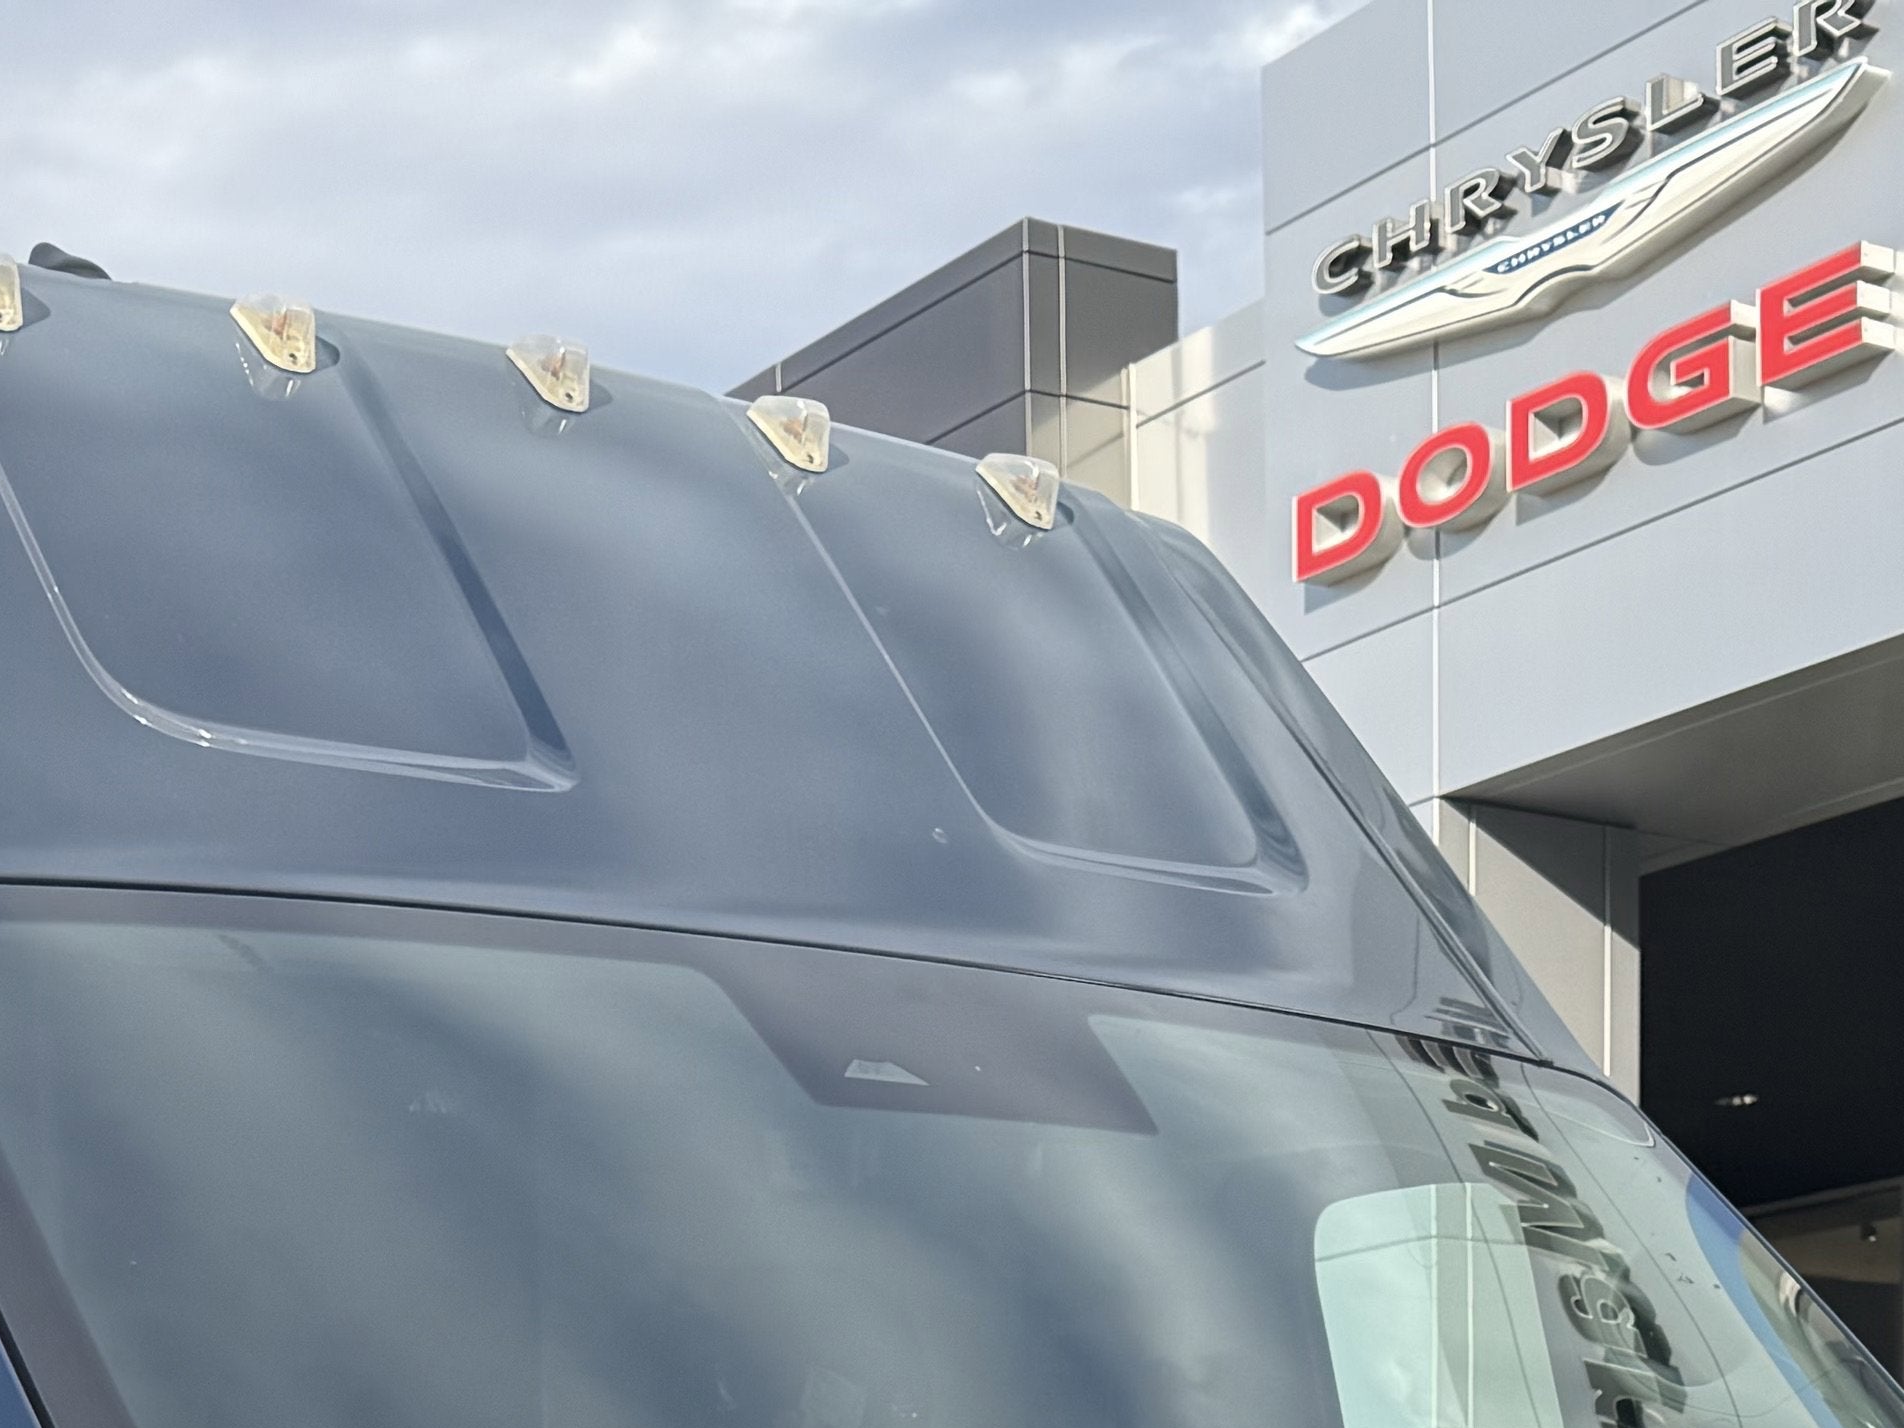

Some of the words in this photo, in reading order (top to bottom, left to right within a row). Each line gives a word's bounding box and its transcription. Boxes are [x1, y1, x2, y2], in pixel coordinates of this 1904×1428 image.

[1312, 0, 1862, 295] CHRYSLER
[1496, 214, 1606, 273] CHRYSLER
[1292, 241, 1886, 583] DODGE
